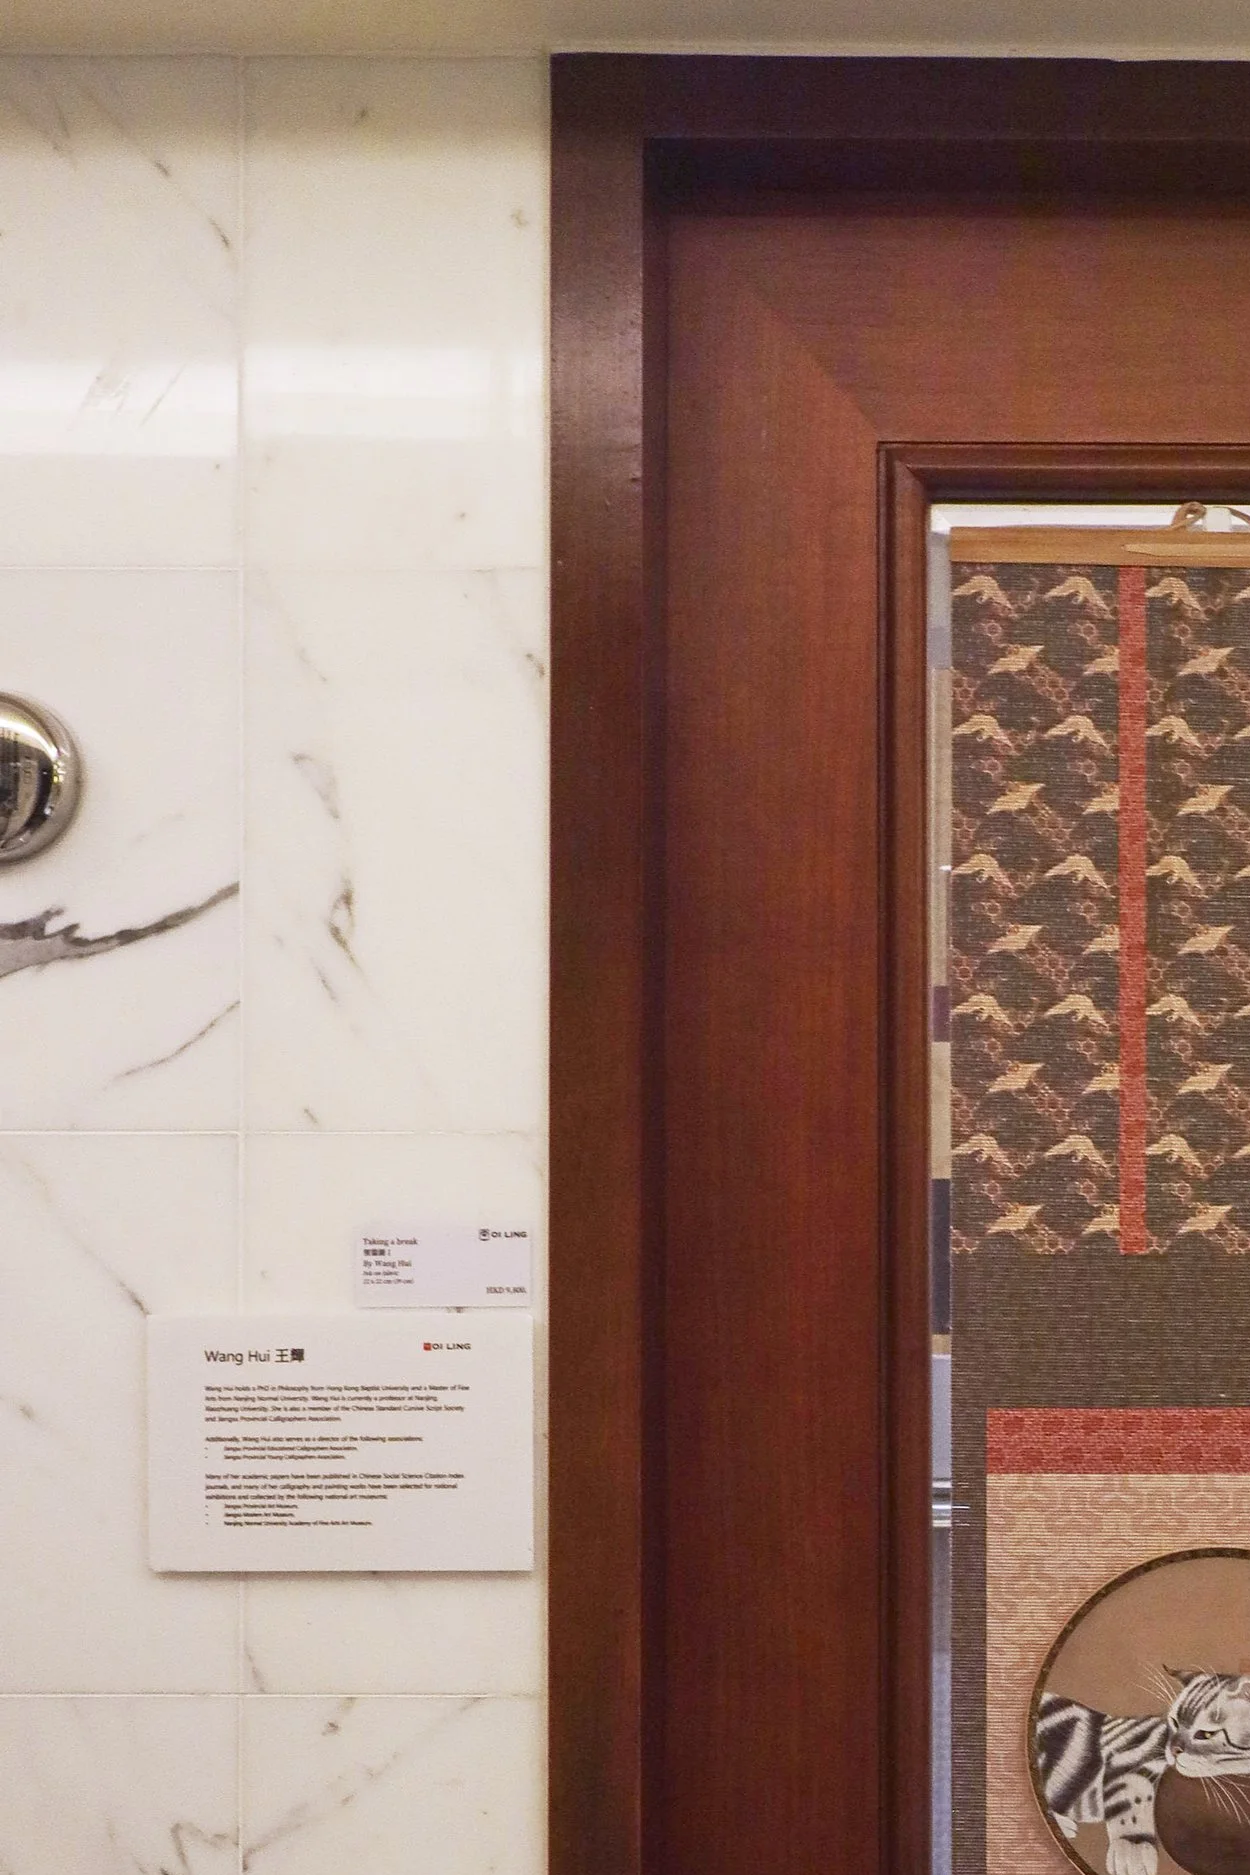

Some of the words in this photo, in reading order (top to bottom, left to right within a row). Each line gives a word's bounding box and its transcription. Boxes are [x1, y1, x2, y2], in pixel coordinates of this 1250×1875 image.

[363, 1238, 389, 1247] Taking
[396, 1237, 418, 1245] break
[363, 1260, 373, 1268] By
[375, 1260, 396, 1269] Wang
[204, 1350, 244, 1366] Wang
[248, 1350, 271, 1362] Hui
